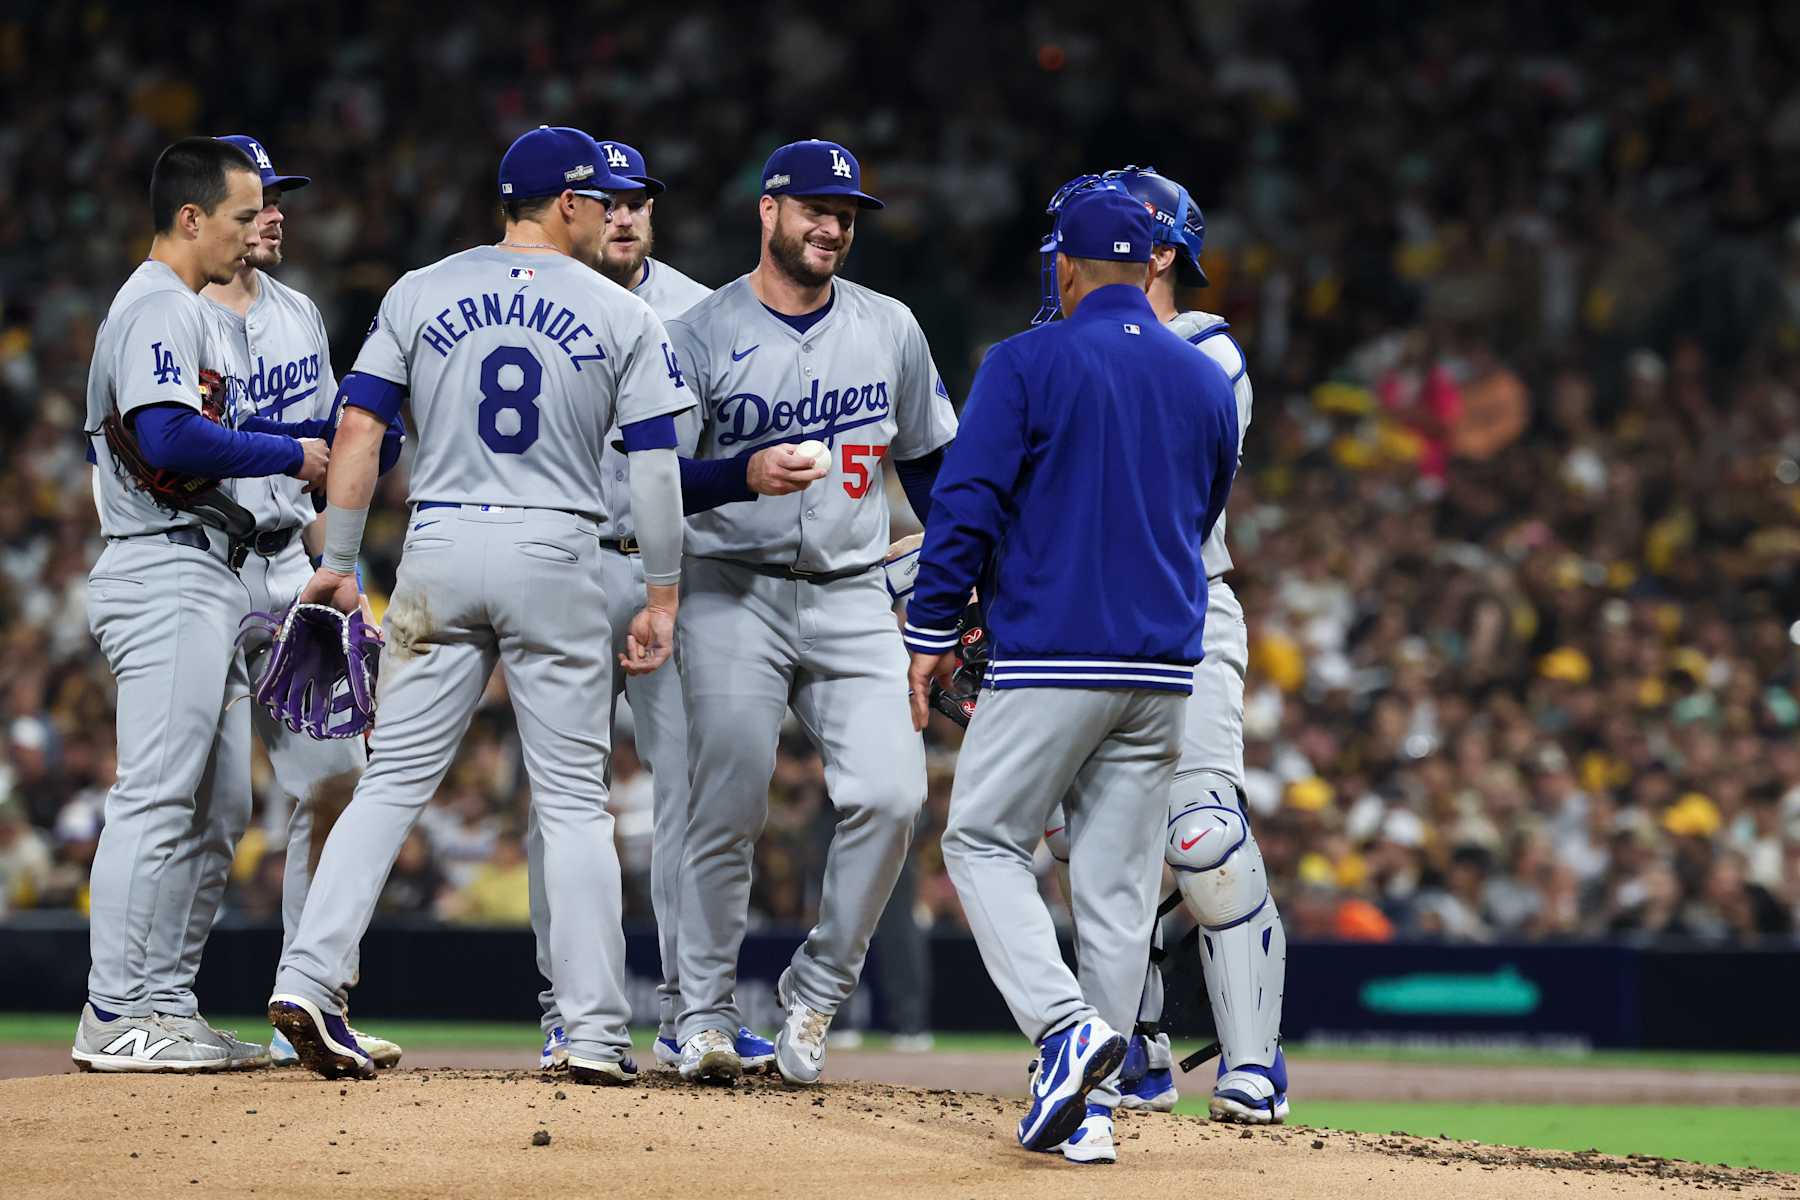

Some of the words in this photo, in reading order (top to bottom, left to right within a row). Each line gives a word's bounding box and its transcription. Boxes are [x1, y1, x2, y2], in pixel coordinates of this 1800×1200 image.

[603, 145, 630, 168] LA
[829, 149, 852, 179] LA
[422, 286, 607, 373] HERNÁNDEZ
[152, 341, 182, 385] LA
[478, 345, 543, 455] 8
[717, 379, 890, 451] Dodgers
